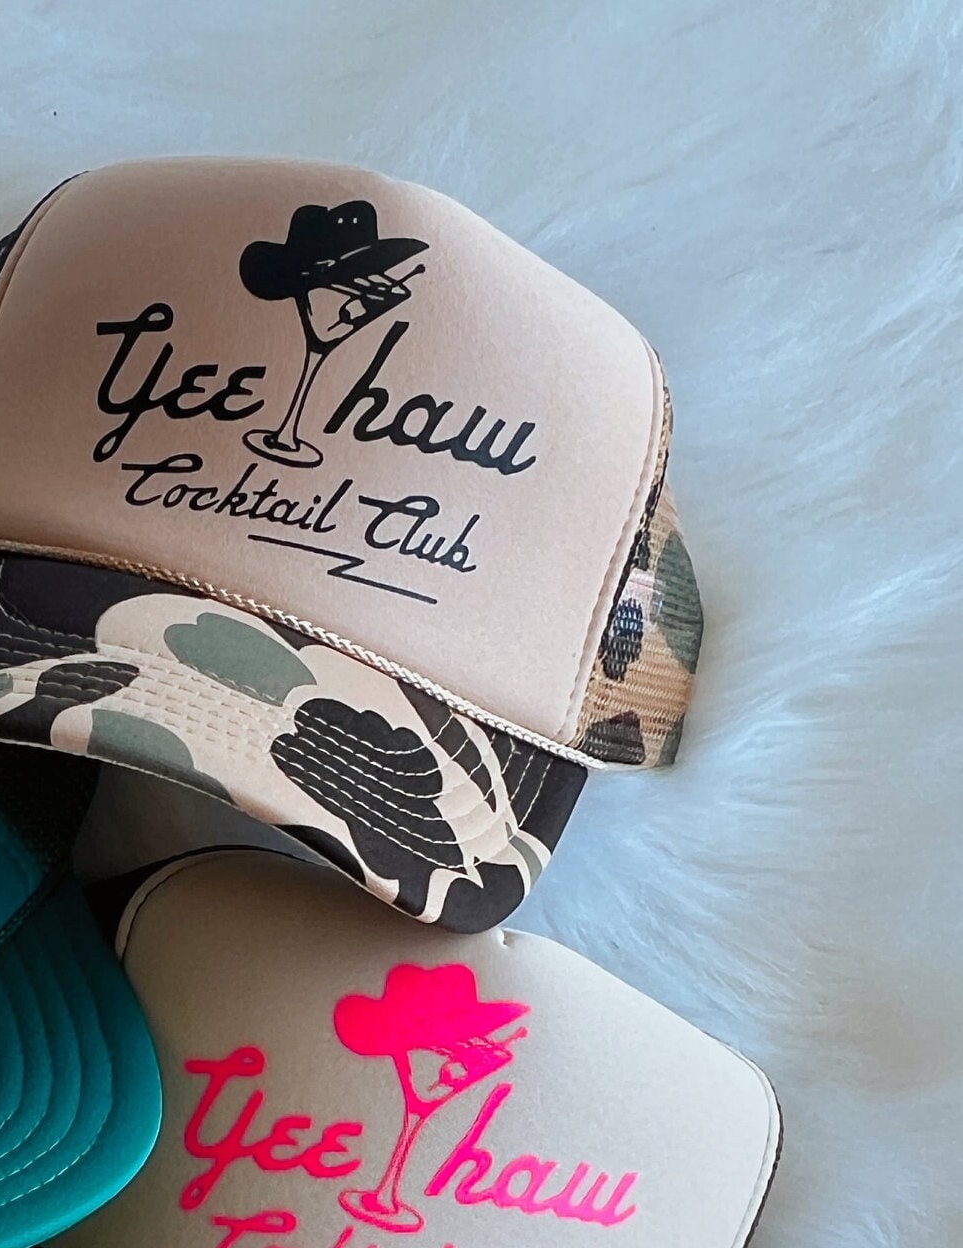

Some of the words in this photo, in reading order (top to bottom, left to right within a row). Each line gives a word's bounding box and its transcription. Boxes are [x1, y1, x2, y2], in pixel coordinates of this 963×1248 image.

[324, 321, 537, 475] haw
[121, 453, 354, 533] Cocktail
[358, 496, 479, 573] Club
[425, 1082, 638, 1227] haw
